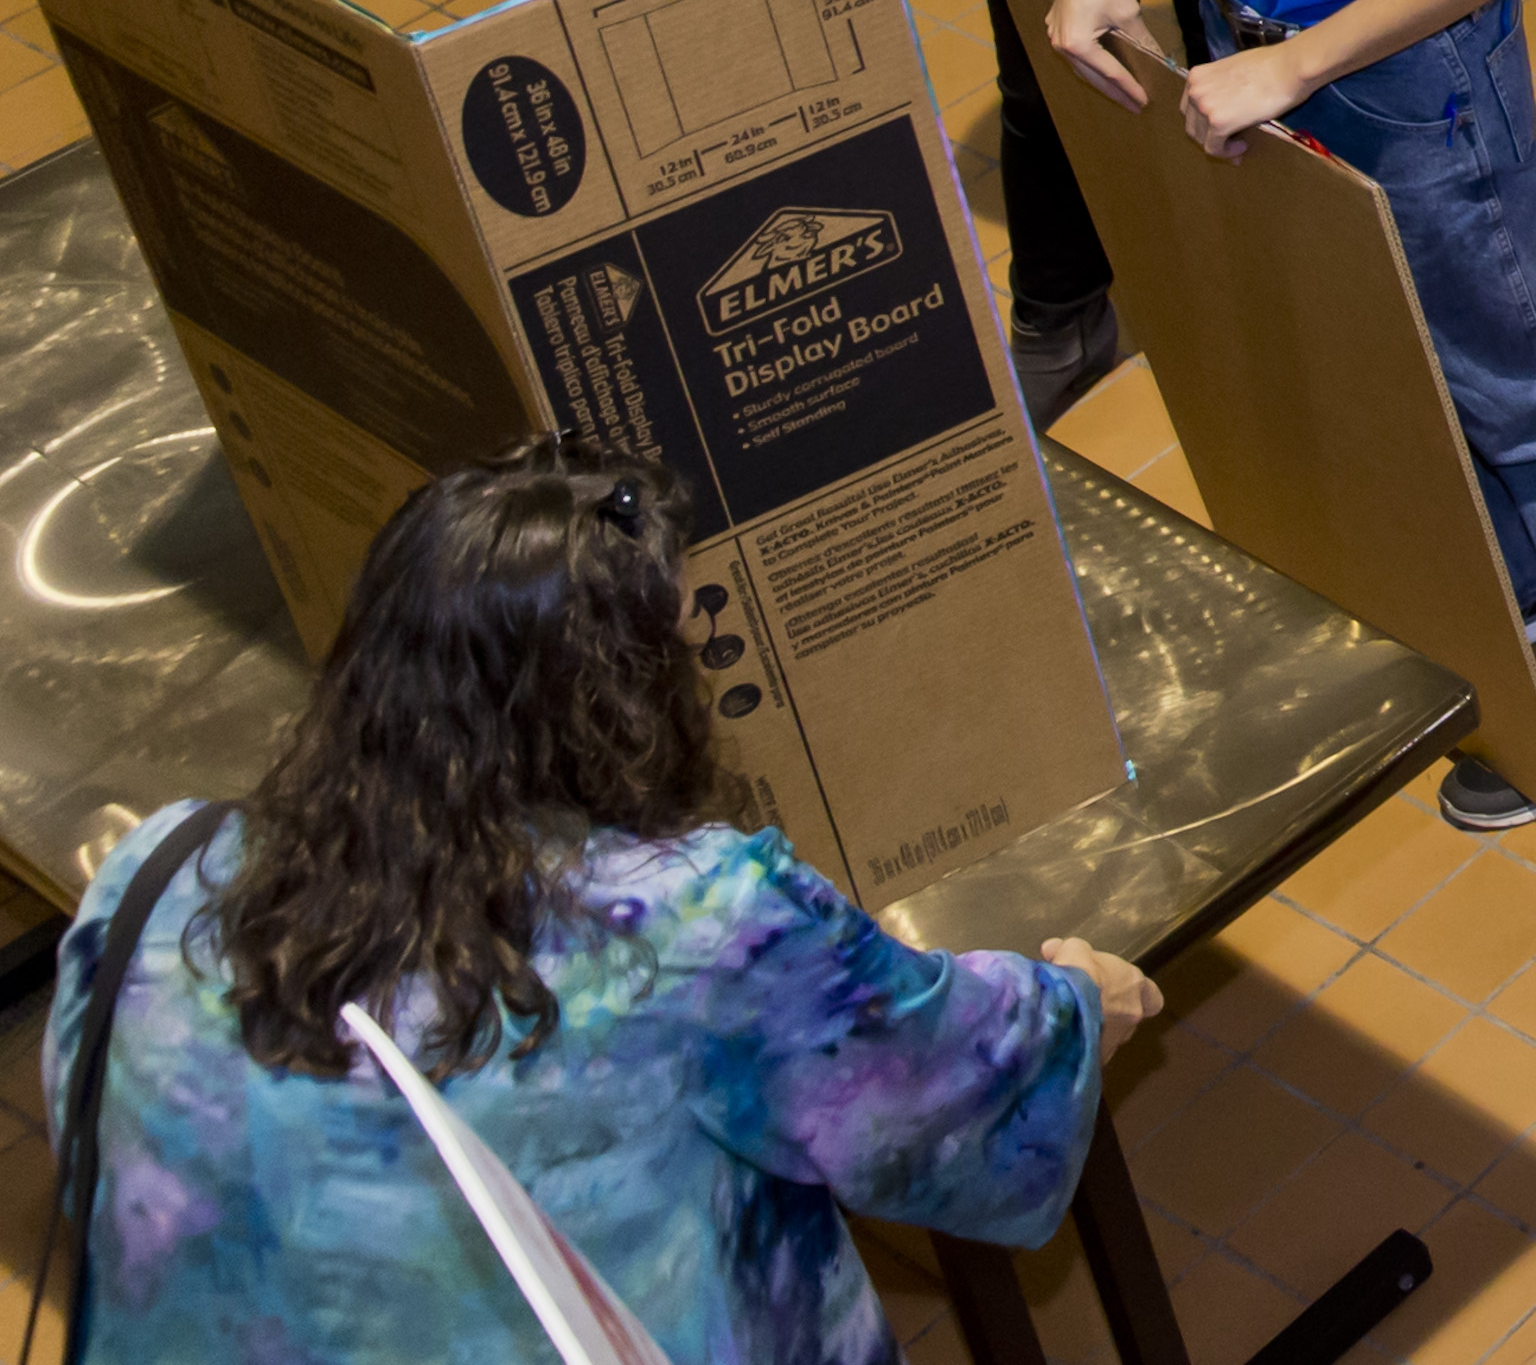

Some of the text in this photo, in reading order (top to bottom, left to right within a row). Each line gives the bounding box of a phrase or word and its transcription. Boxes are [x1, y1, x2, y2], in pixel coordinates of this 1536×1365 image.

[526, 78, 551, 105] 36
[546, 135, 569, 160] 48
[553, 155, 572, 177] in
[530, 186, 552, 214] cm
[590, 269, 620, 327] ELMER'S
[720, 228, 886, 322] ELMER'S
[533, 284, 598, 434] Tablero para
[713, 296, 843, 369] Tri-Fold
[724, 282, 945, 398] Display Board
[604, 332, 640, 395] Tri-Fold
[624, 390, 658, 448] Display
[742, 331, 919, 419] Sturdy corrugated board
[748, 375, 861, 433] Smooth surface
[752, 399, 847, 447] Self Standing
[814, 504, 859, 531] Knives
[961, 433, 1014, 463] Markers
[1000, 459, 1018, 475] les
[754, 527, 778, 546] Get
[778, 511, 817, 535] Great
[866, 476, 892, 496] Use
[891, 455, 938, 484] Elmer's
[777, 525, 840, 561] Complete
[839, 510, 871, 532] Your
[845, 556, 864, 571] de
[863, 530, 918, 564] peinture
[972, 491, 1004, 513] pour
[828, 568, 864, 591] votre
[880, 591, 902, 608] con
[1004, 527, 1036, 550] para
[786, 619, 812, 640] Use
[810, 590, 876, 627] adhesivos
[792, 625, 858, 661] completar
